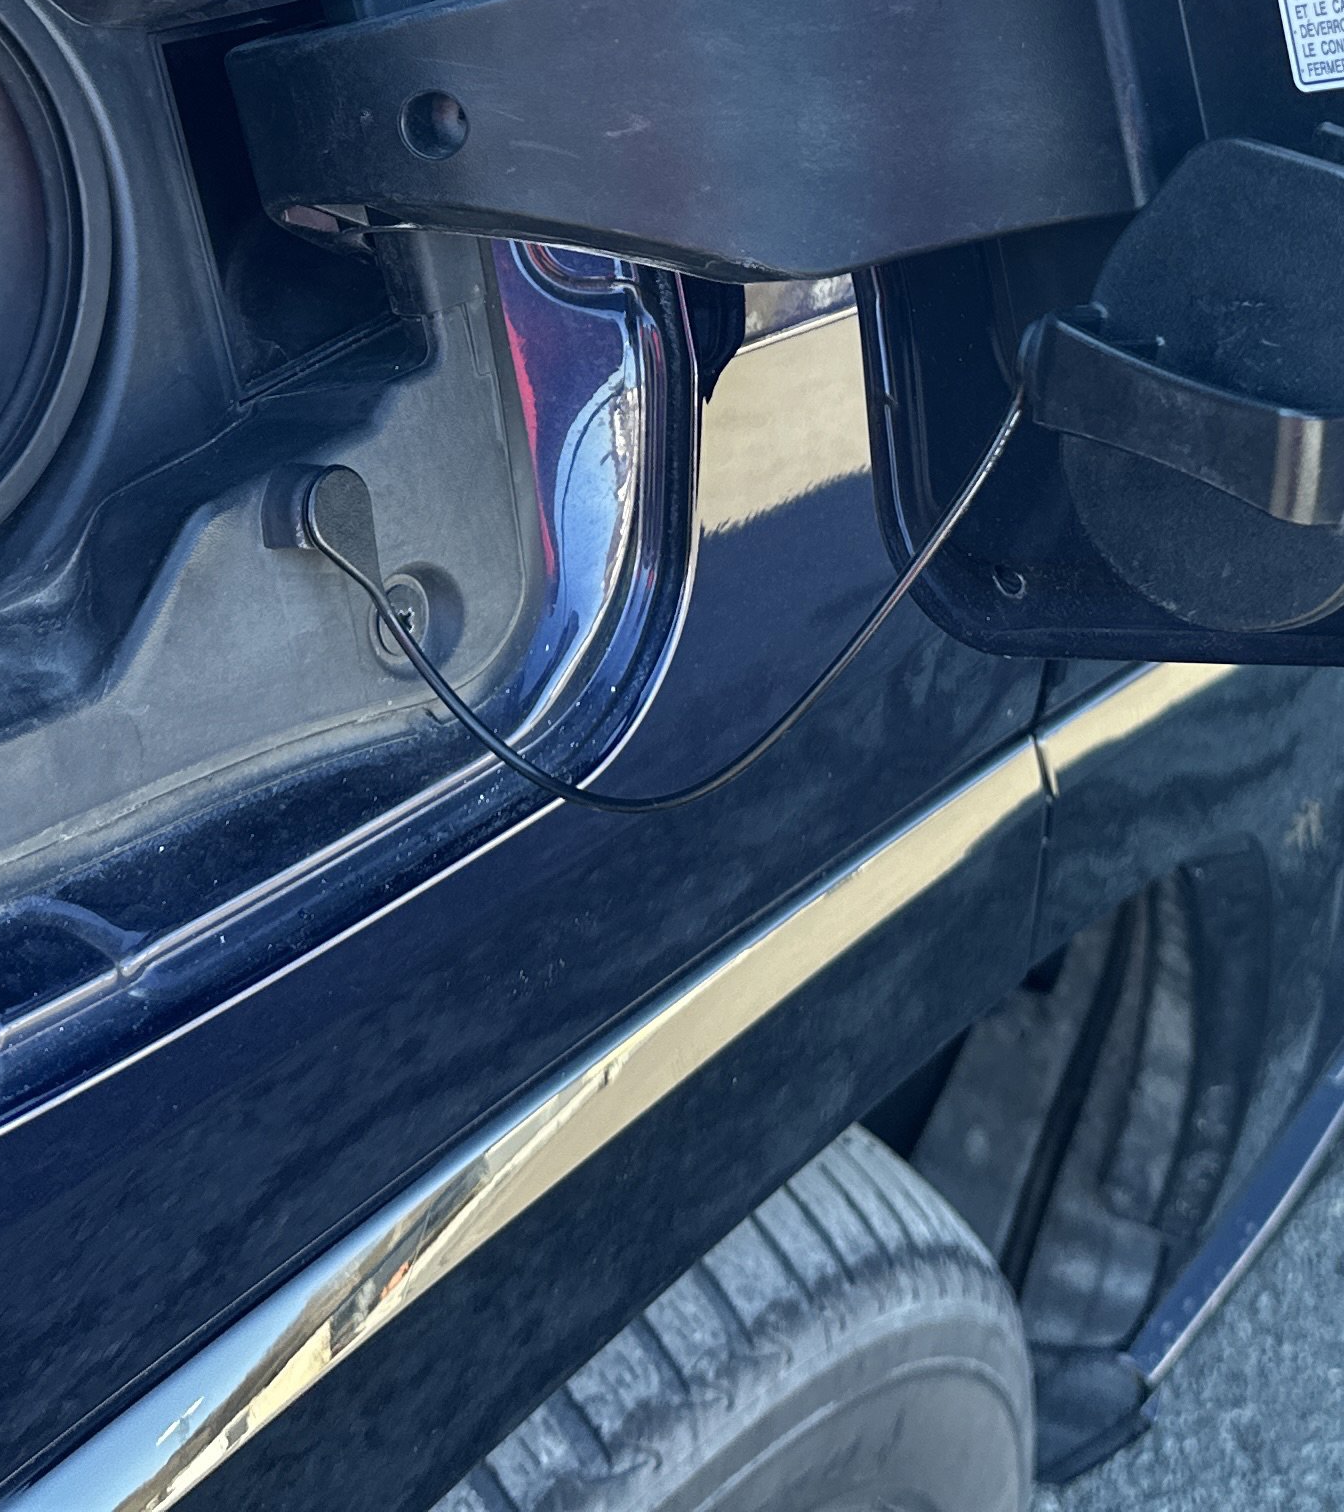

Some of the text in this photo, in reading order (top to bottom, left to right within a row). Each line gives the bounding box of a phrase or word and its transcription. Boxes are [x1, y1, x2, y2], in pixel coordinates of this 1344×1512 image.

[1295, 4, 1307, 19] ET
[1313, 0, 1327, 17] LE
[1302, 42, 1316, 58] LE
